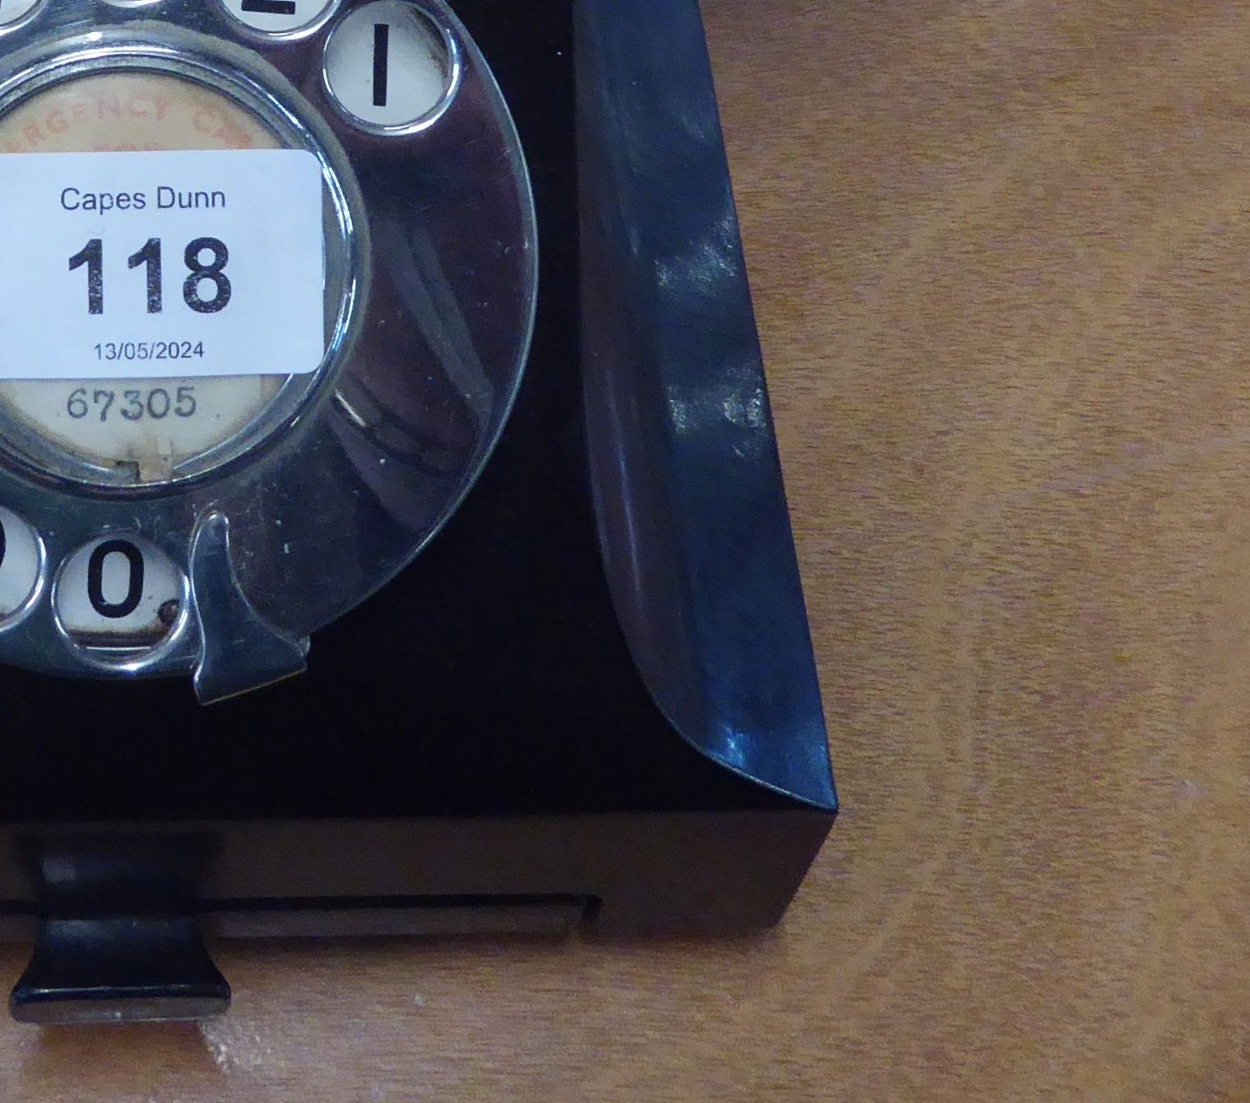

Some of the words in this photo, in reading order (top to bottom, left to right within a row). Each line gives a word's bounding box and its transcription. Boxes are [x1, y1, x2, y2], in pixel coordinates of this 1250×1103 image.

[372, 22, 389, 107] 1
[60, 187, 147, 216] Capes
[156, 186, 227, 210] Dunn
[68, 236, 233, 315] 118
[93, 340, 205, 361] 13/05/2024
[66, 385, 198, 421] 67305
[86, 538, 144, 619] 0
